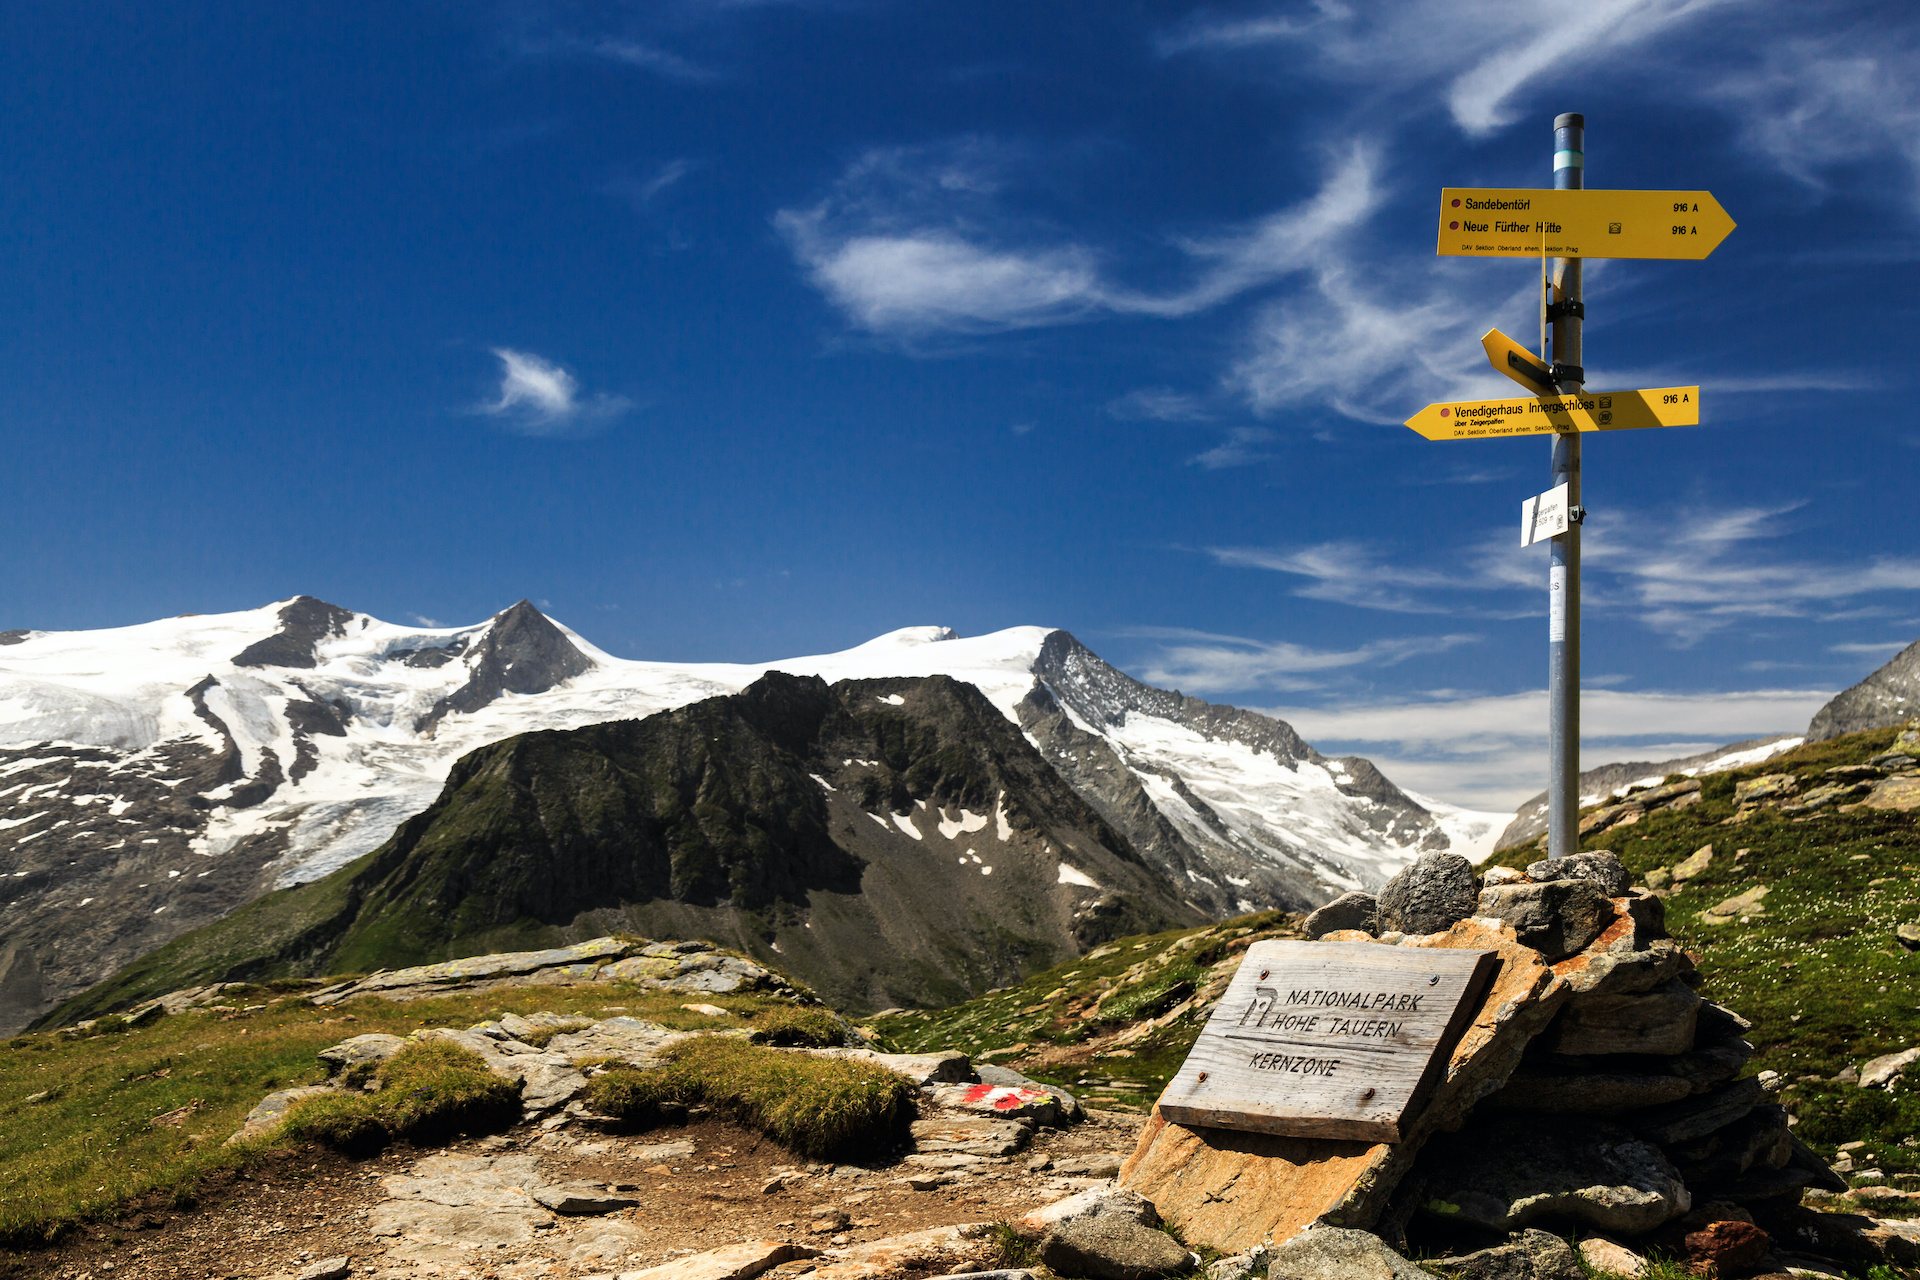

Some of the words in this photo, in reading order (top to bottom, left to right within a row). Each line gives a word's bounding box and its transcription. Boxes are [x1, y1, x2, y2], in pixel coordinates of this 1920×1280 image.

[1465, 198, 1530, 210] Sandebentörl
[1673, 203, 1688, 212] 916
[1692, 203, 1698, 212] A
[1463, 220, 1489, 232] Neue
[1495, 221, 1530, 233] Fürther
[1535, 221, 1562, 233] Hütte
[1672, 225, 1686, 234] 916
[1691, 226, 1697, 235] A
[1475, 244, 1495, 252] Sektion
[1565, 246, 1579, 254] Prag
[1663, 394, 1678, 404] 916
[1682, 393, 1689, 403] A
[1454, 404, 1523, 418] Venedigerhaus
[1529, 398, 1595, 415] Innergschlöss
[1534, 425, 1555, 433] Sektion
[1557, 424, 1570, 432] Prag
[1286, 989, 1424, 1012] NATIONALPARK
[1271, 1014, 1320, 1033] HOHE
[1329, 1016, 1403, 1039] TAUERN
[1249, 1052, 1341, 1077] KERNZONE
